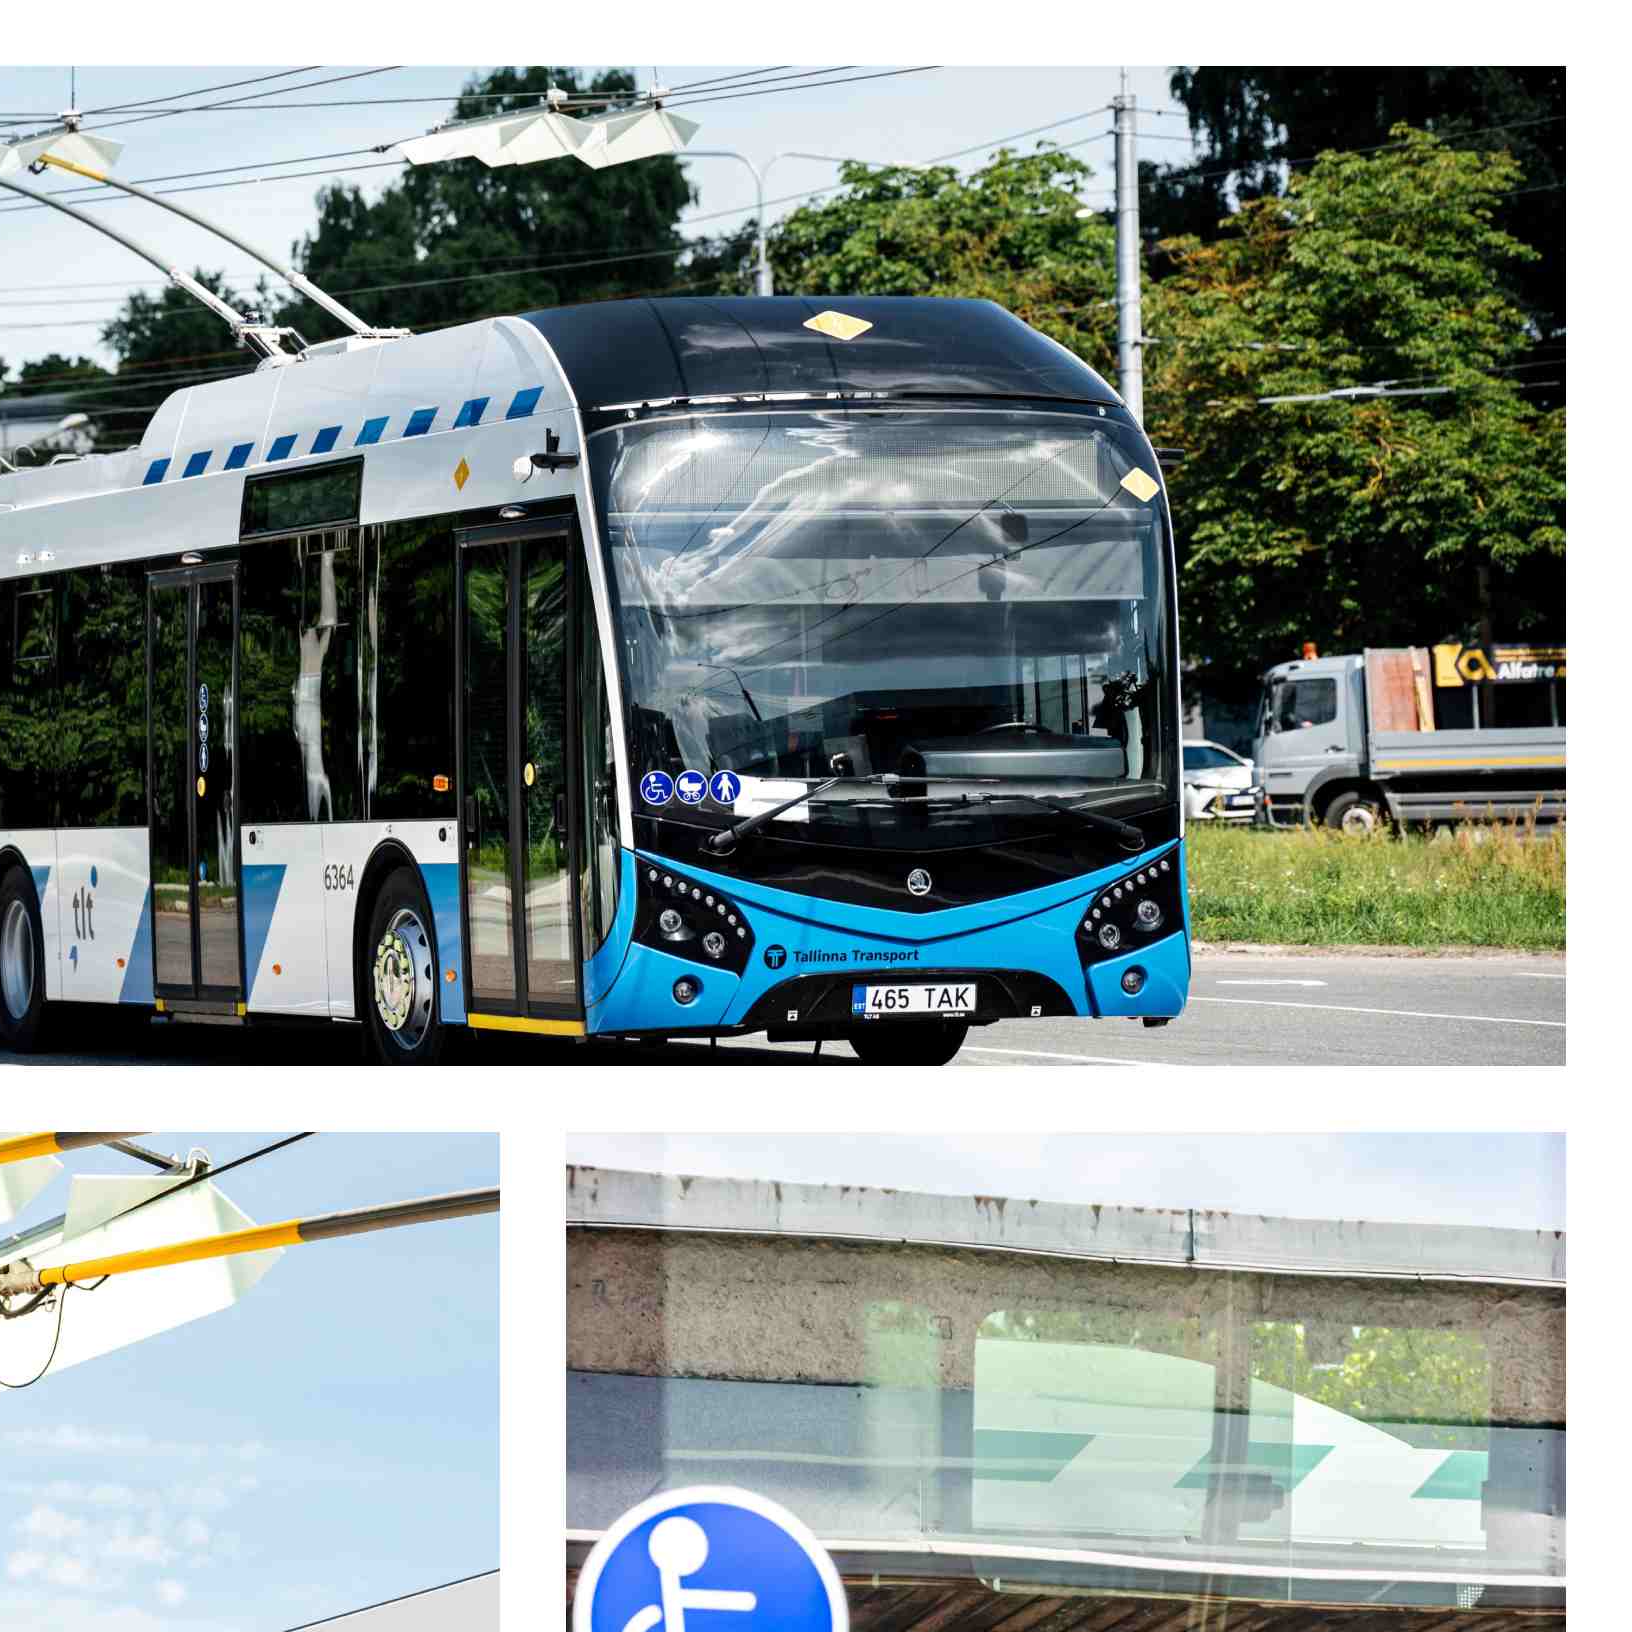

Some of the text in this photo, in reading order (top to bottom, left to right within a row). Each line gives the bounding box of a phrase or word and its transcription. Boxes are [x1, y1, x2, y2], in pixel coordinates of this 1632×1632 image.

[324, 863, 354, 891] 6364
[72, 886, 95, 941] tlt
[793, 948, 919, 965] Tallinna Transport
[871, 987, 970, 1009] 465 TAK
